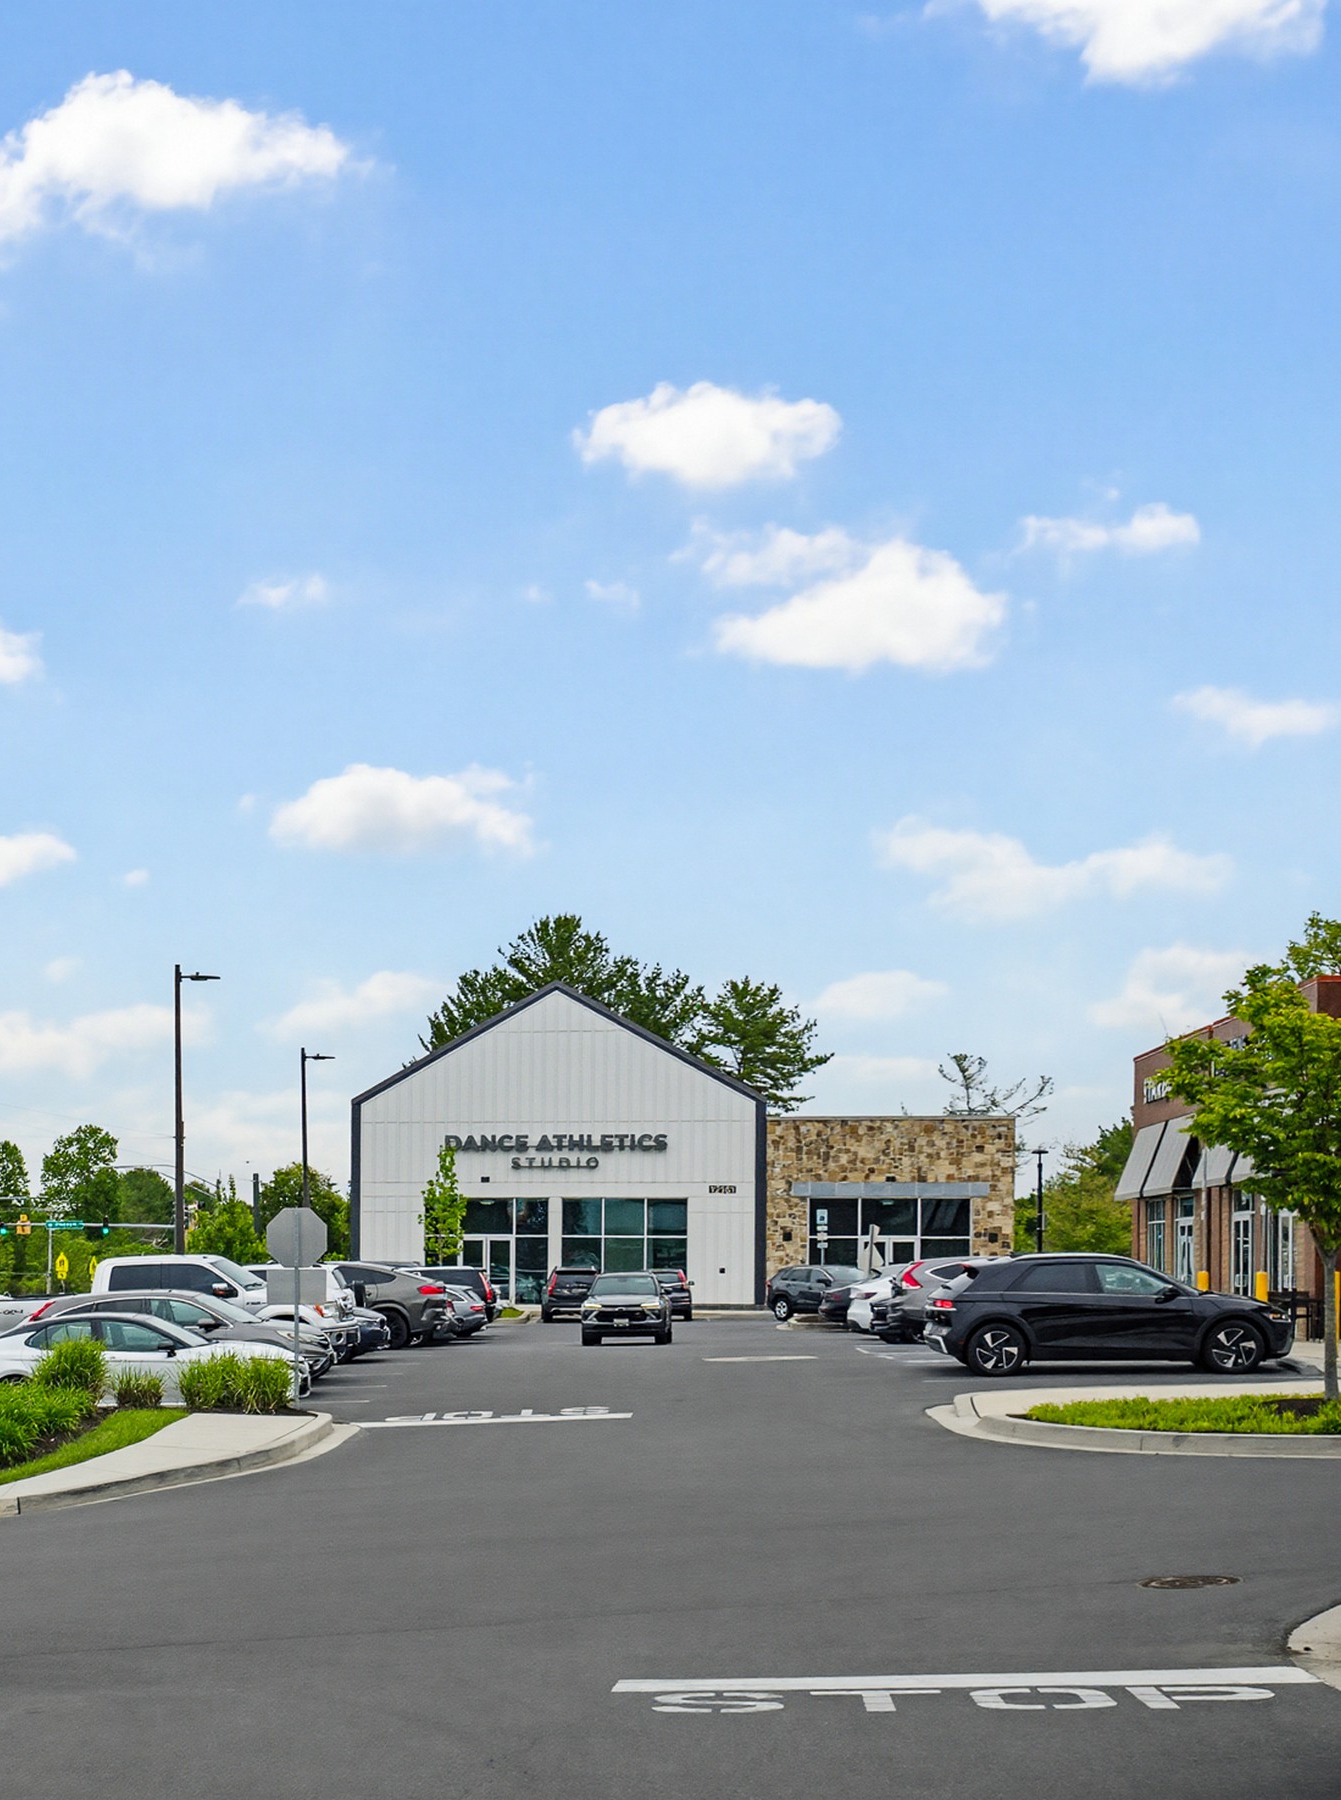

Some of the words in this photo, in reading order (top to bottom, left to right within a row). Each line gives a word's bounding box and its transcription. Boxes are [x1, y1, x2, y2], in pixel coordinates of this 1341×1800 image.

[444, 1134, 529, 1152] DANCE
[535, 1133, 668, 1152] ATHLETICS
[511, 1156, 599, 1170] STUDIO
[385, 1406, 610, 1422] STOP
[651, 1684, 1276, 1714] STOP
